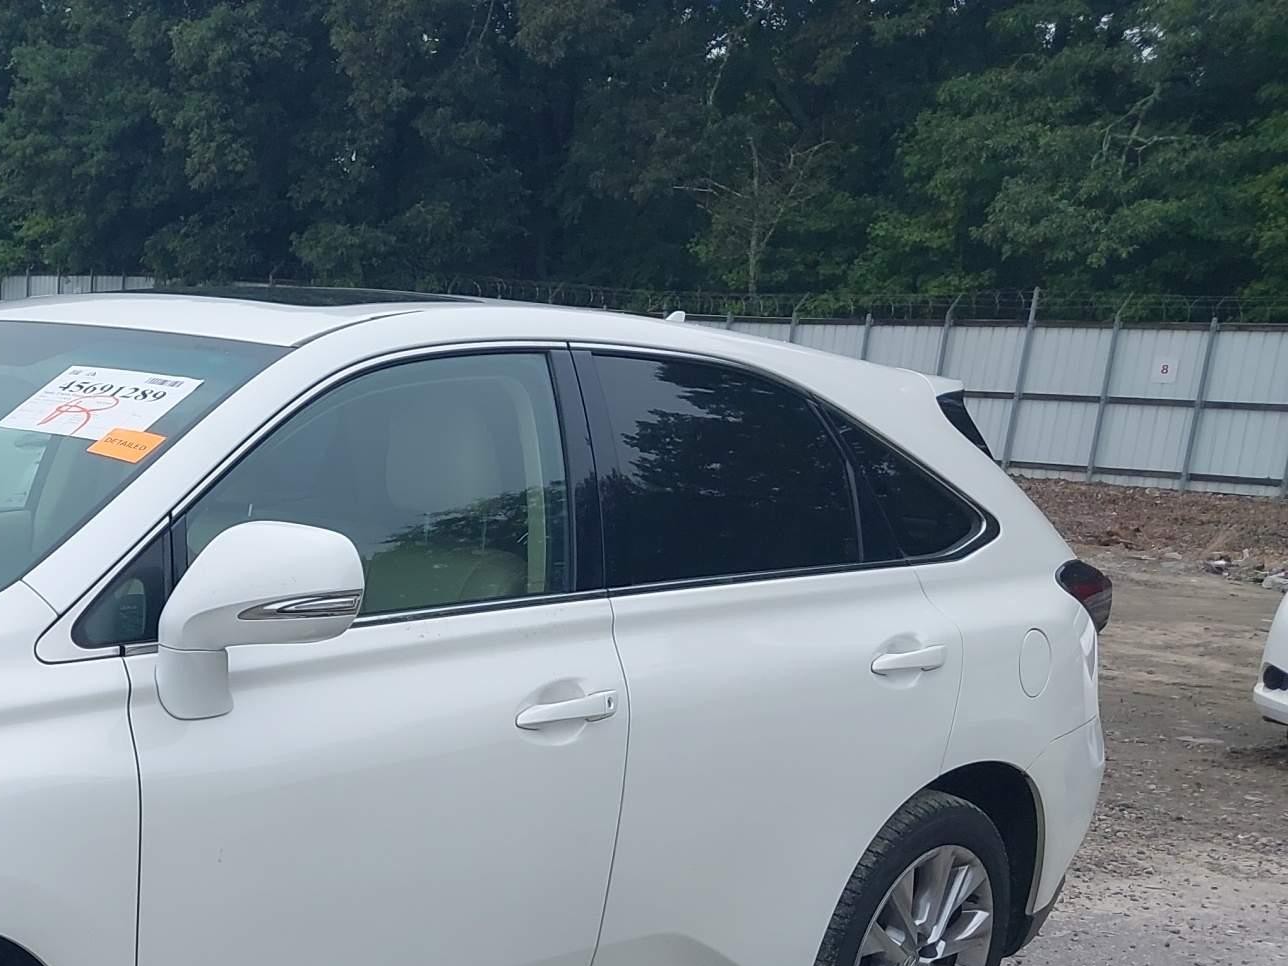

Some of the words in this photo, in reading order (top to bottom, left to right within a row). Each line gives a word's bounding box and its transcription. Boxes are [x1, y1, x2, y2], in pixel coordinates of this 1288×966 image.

[1160, 364, 1169, 375] 8
[59, 380, 167, 402] 45691289
[103, 436, 148, 451] DETAILED
